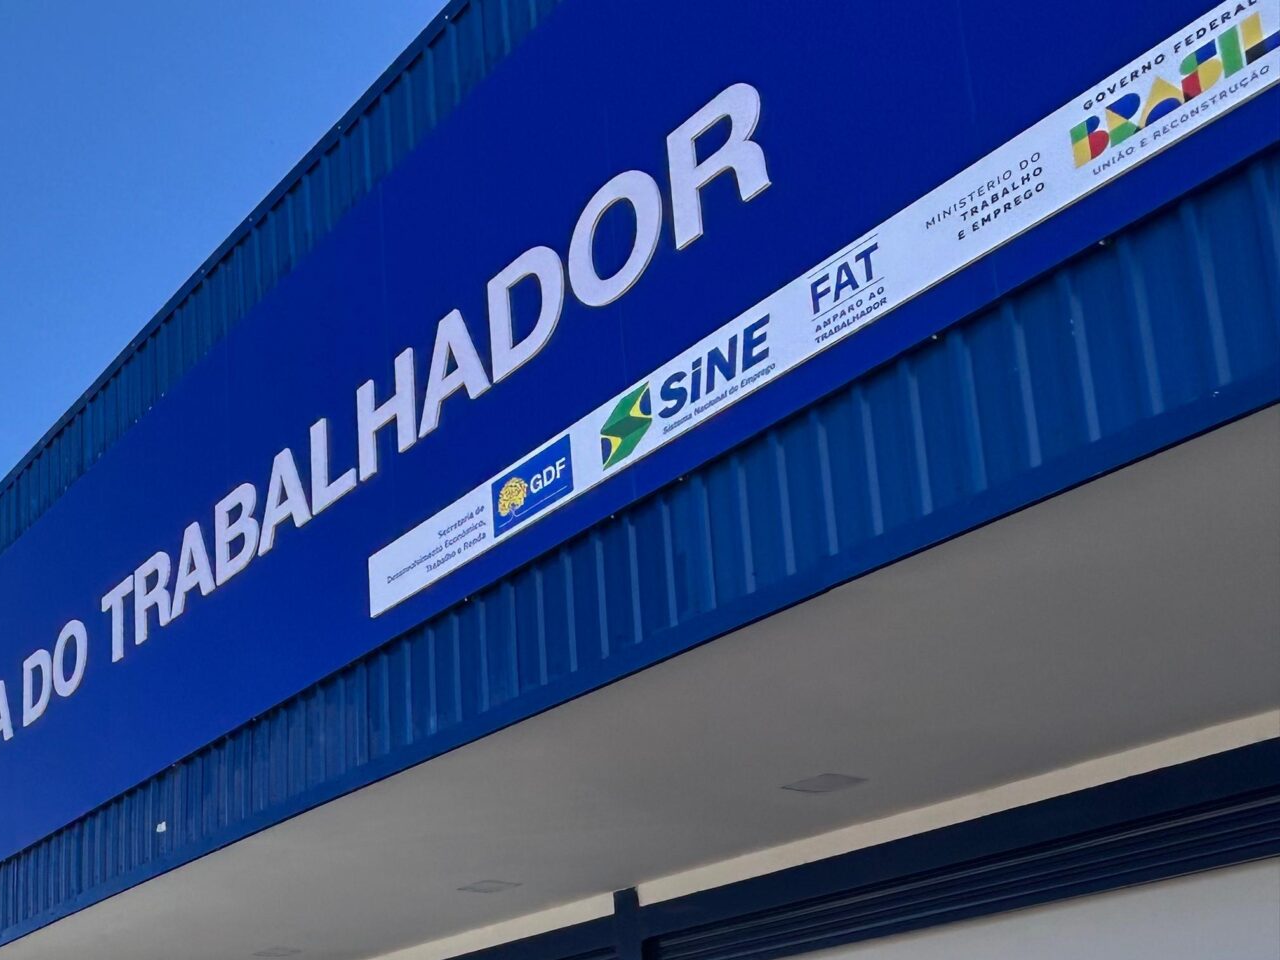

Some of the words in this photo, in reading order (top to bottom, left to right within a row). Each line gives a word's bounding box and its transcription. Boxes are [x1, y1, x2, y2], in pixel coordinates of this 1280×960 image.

[1082, 53, 1166, 111] GOVERNO
[1173, 0, 1258, 54] FEDERAL
[1070, 11, 1280, 169] BRASIL
[1092, 146, 1135, 175] UNIÃO
[1139, 138, 1148, 148] E
[1152, 65, 1270, 140] RECONSTRUÇÃO
[1019, 152, 1041, 170] DO
[957, 230, 966, 240] E
[972, 182, 1045, 232] EMPREGO
[960, 167, 1043, 222] TRABALHO
[810, 242, 879, 315] FAT
[814, 297, 888, 343] TRABALHADOR
[815, 299, 864, 333] AMPARO
[868, 286, 885, 300] AO
[22, 619, 88, 727] DO
[101, 82, 772, 663] TRABALHADOR
[694, 390, 728, 416] Nacional
[740, 363, 776, 388] Emprego
[530, 457, 566, 493] GDF
